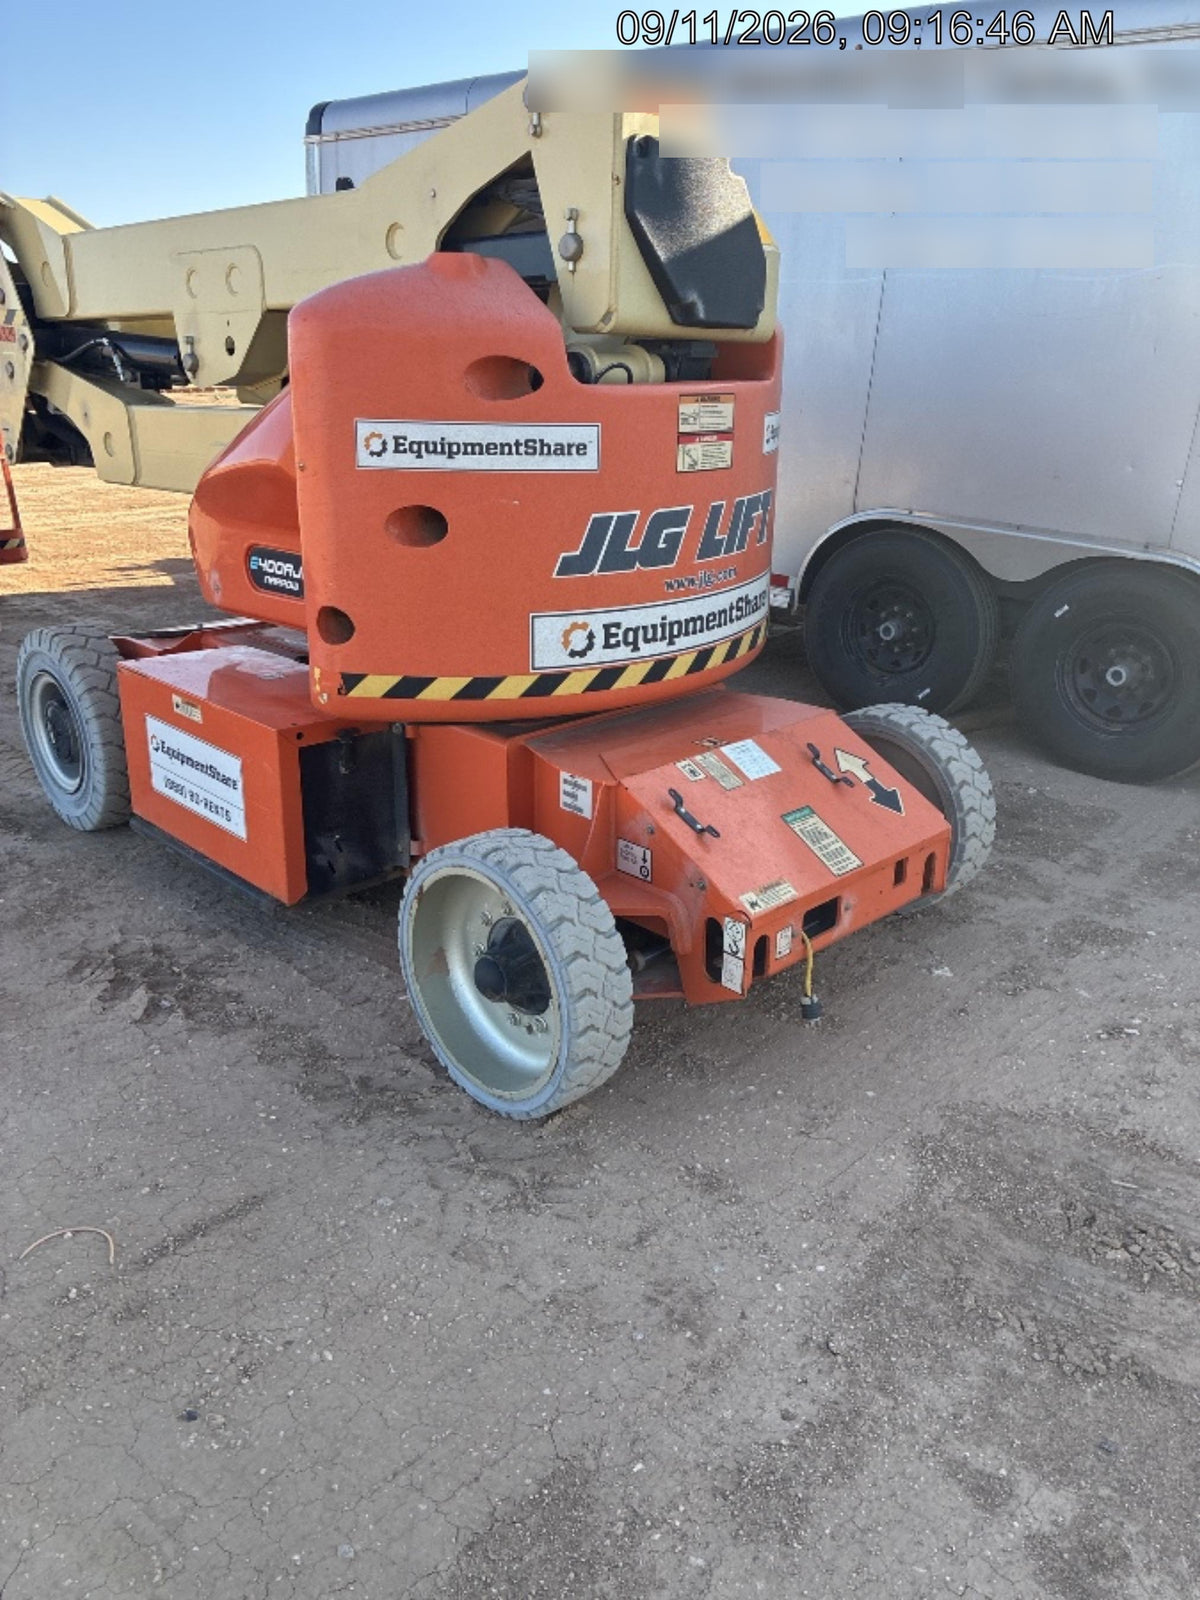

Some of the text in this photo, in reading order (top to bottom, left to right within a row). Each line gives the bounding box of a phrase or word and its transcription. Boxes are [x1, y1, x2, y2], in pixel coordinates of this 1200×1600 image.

[392, 435, 588, 459] EquipmentShare
[552, 489, 773, 578] JLG LIFT
[664, 565, 737, 592] www.jlg.com
[602, 589, 767, 652] EquipmentShare
